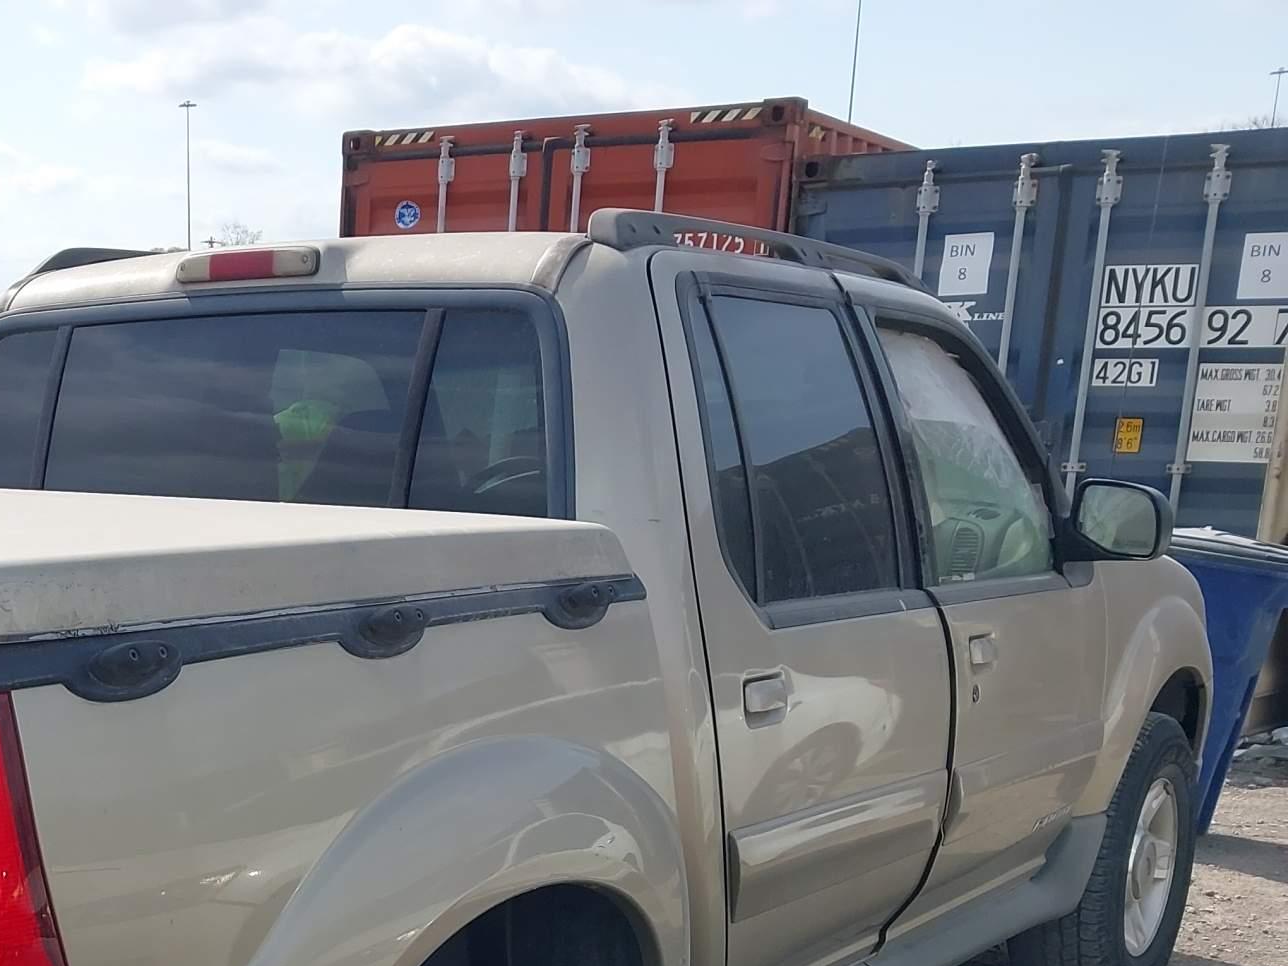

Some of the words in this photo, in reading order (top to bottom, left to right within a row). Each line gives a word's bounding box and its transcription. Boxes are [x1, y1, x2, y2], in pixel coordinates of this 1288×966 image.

[950, 244, 976, 257] BIN
[1250, 244, 1281, 257] BIN
[958, 267, 967, 281] 8
[1260, 268, 1272, 283] 8
[1105, 267, 1196, 304] NYKU
[1099, 310, 1187, 346] 8456
[1207, 309, 1252, 345] 92
[1095, 361, 1156, 385] 42G1
